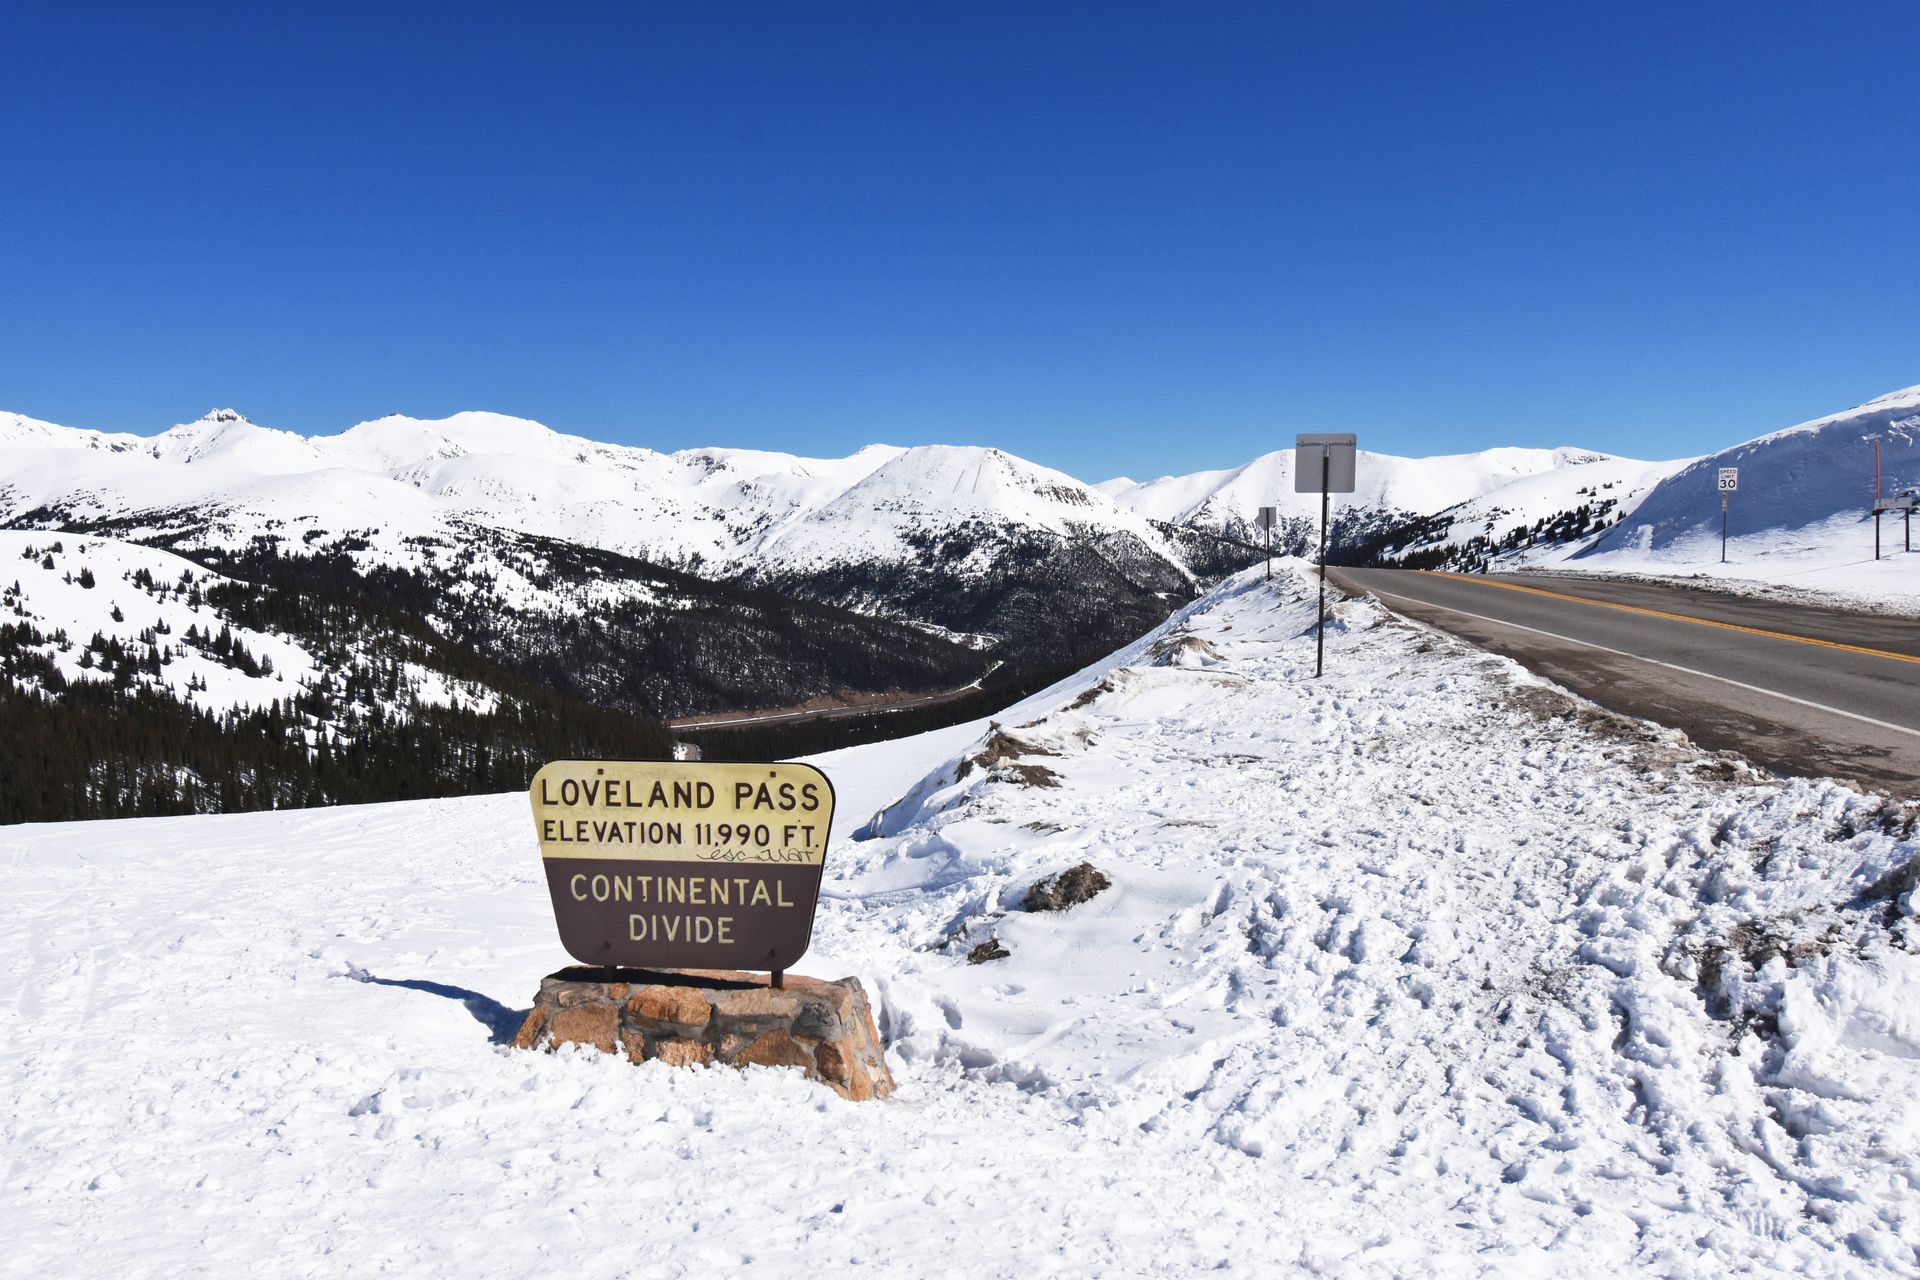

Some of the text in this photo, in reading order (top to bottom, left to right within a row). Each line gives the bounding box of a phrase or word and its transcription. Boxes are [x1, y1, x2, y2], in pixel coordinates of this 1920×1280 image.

[1719, 479, 1736, 488] 30
[541, 778, 820, 812] LOVELAND PASS
[543, 819, 819, 849] ELEVATION 11,990 FT.
[570, 873, 795, 908] CONTINENTAL
[628, 913, 735, 945] DIVIDE
